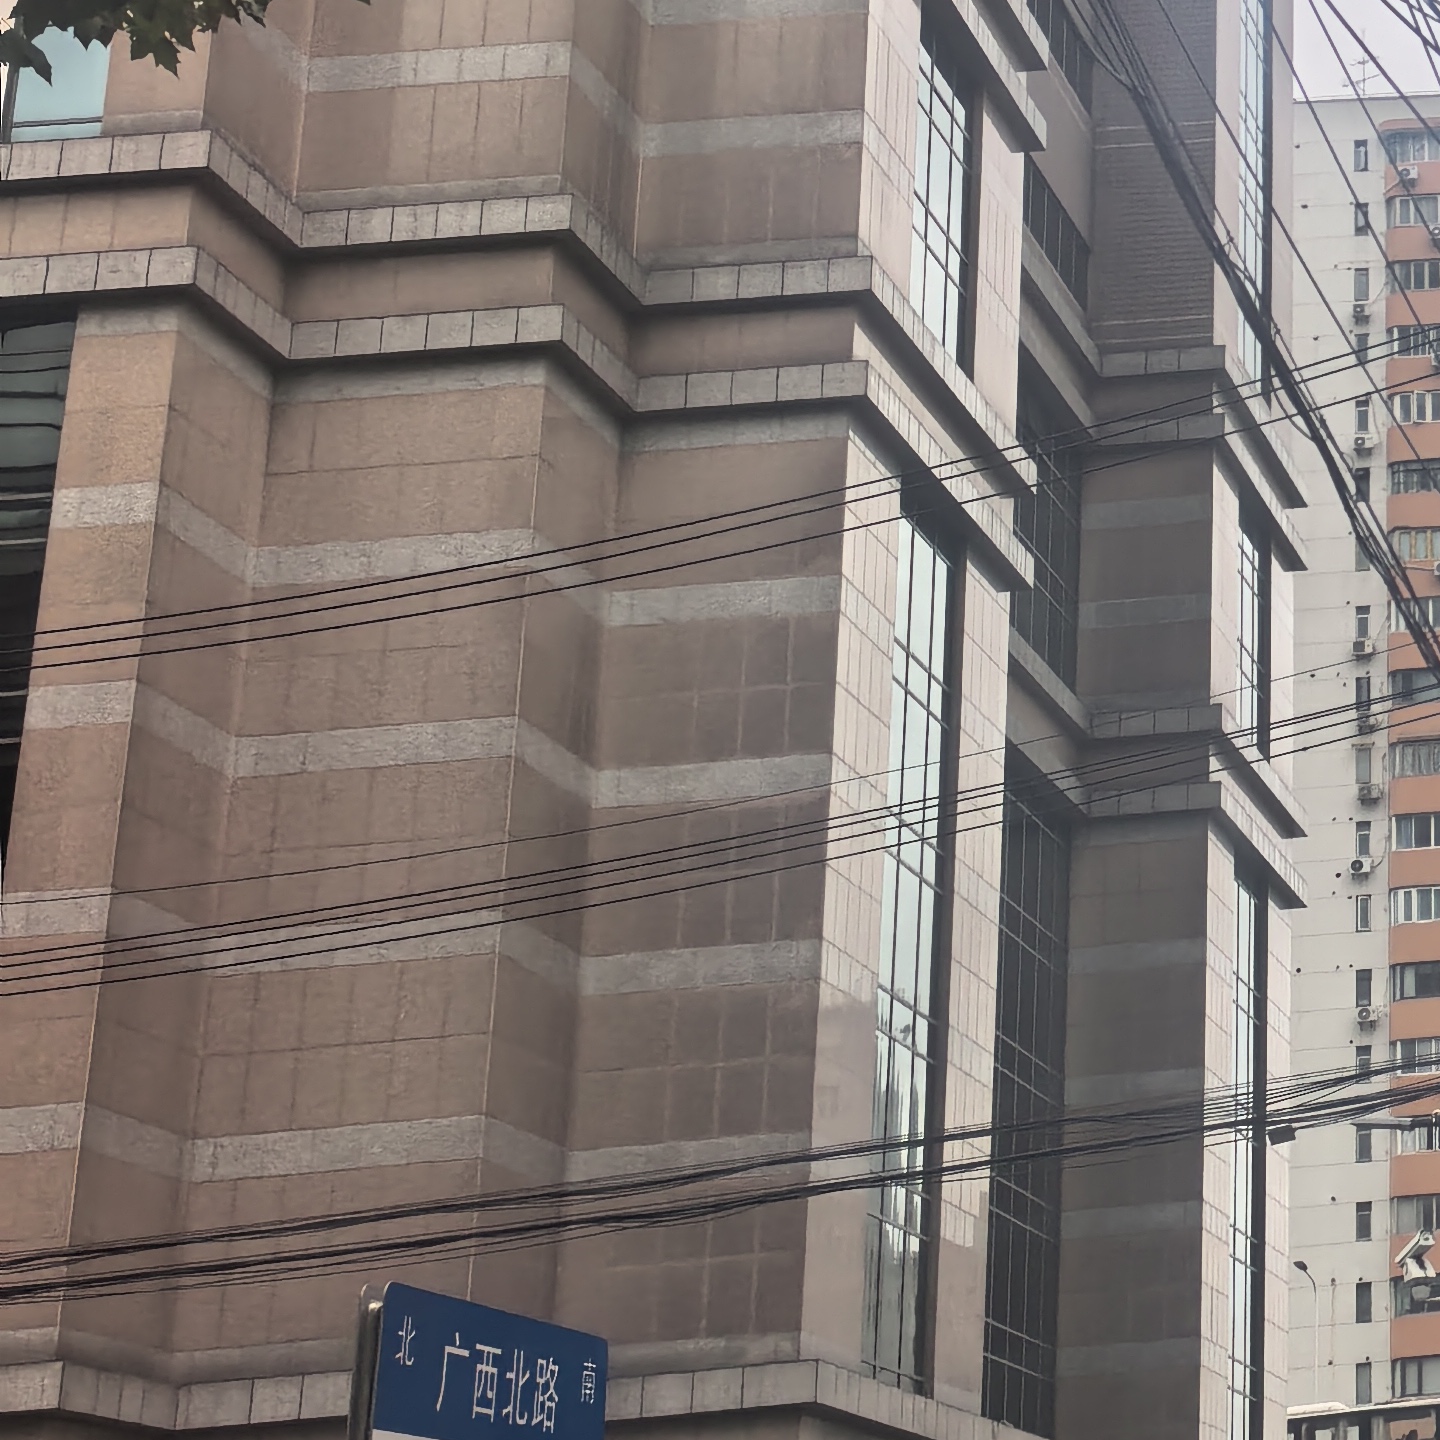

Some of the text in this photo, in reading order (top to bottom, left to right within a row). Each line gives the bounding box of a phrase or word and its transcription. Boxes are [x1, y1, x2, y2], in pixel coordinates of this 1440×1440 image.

[394, 1315, 597, 1434] 北 广西北路 南
